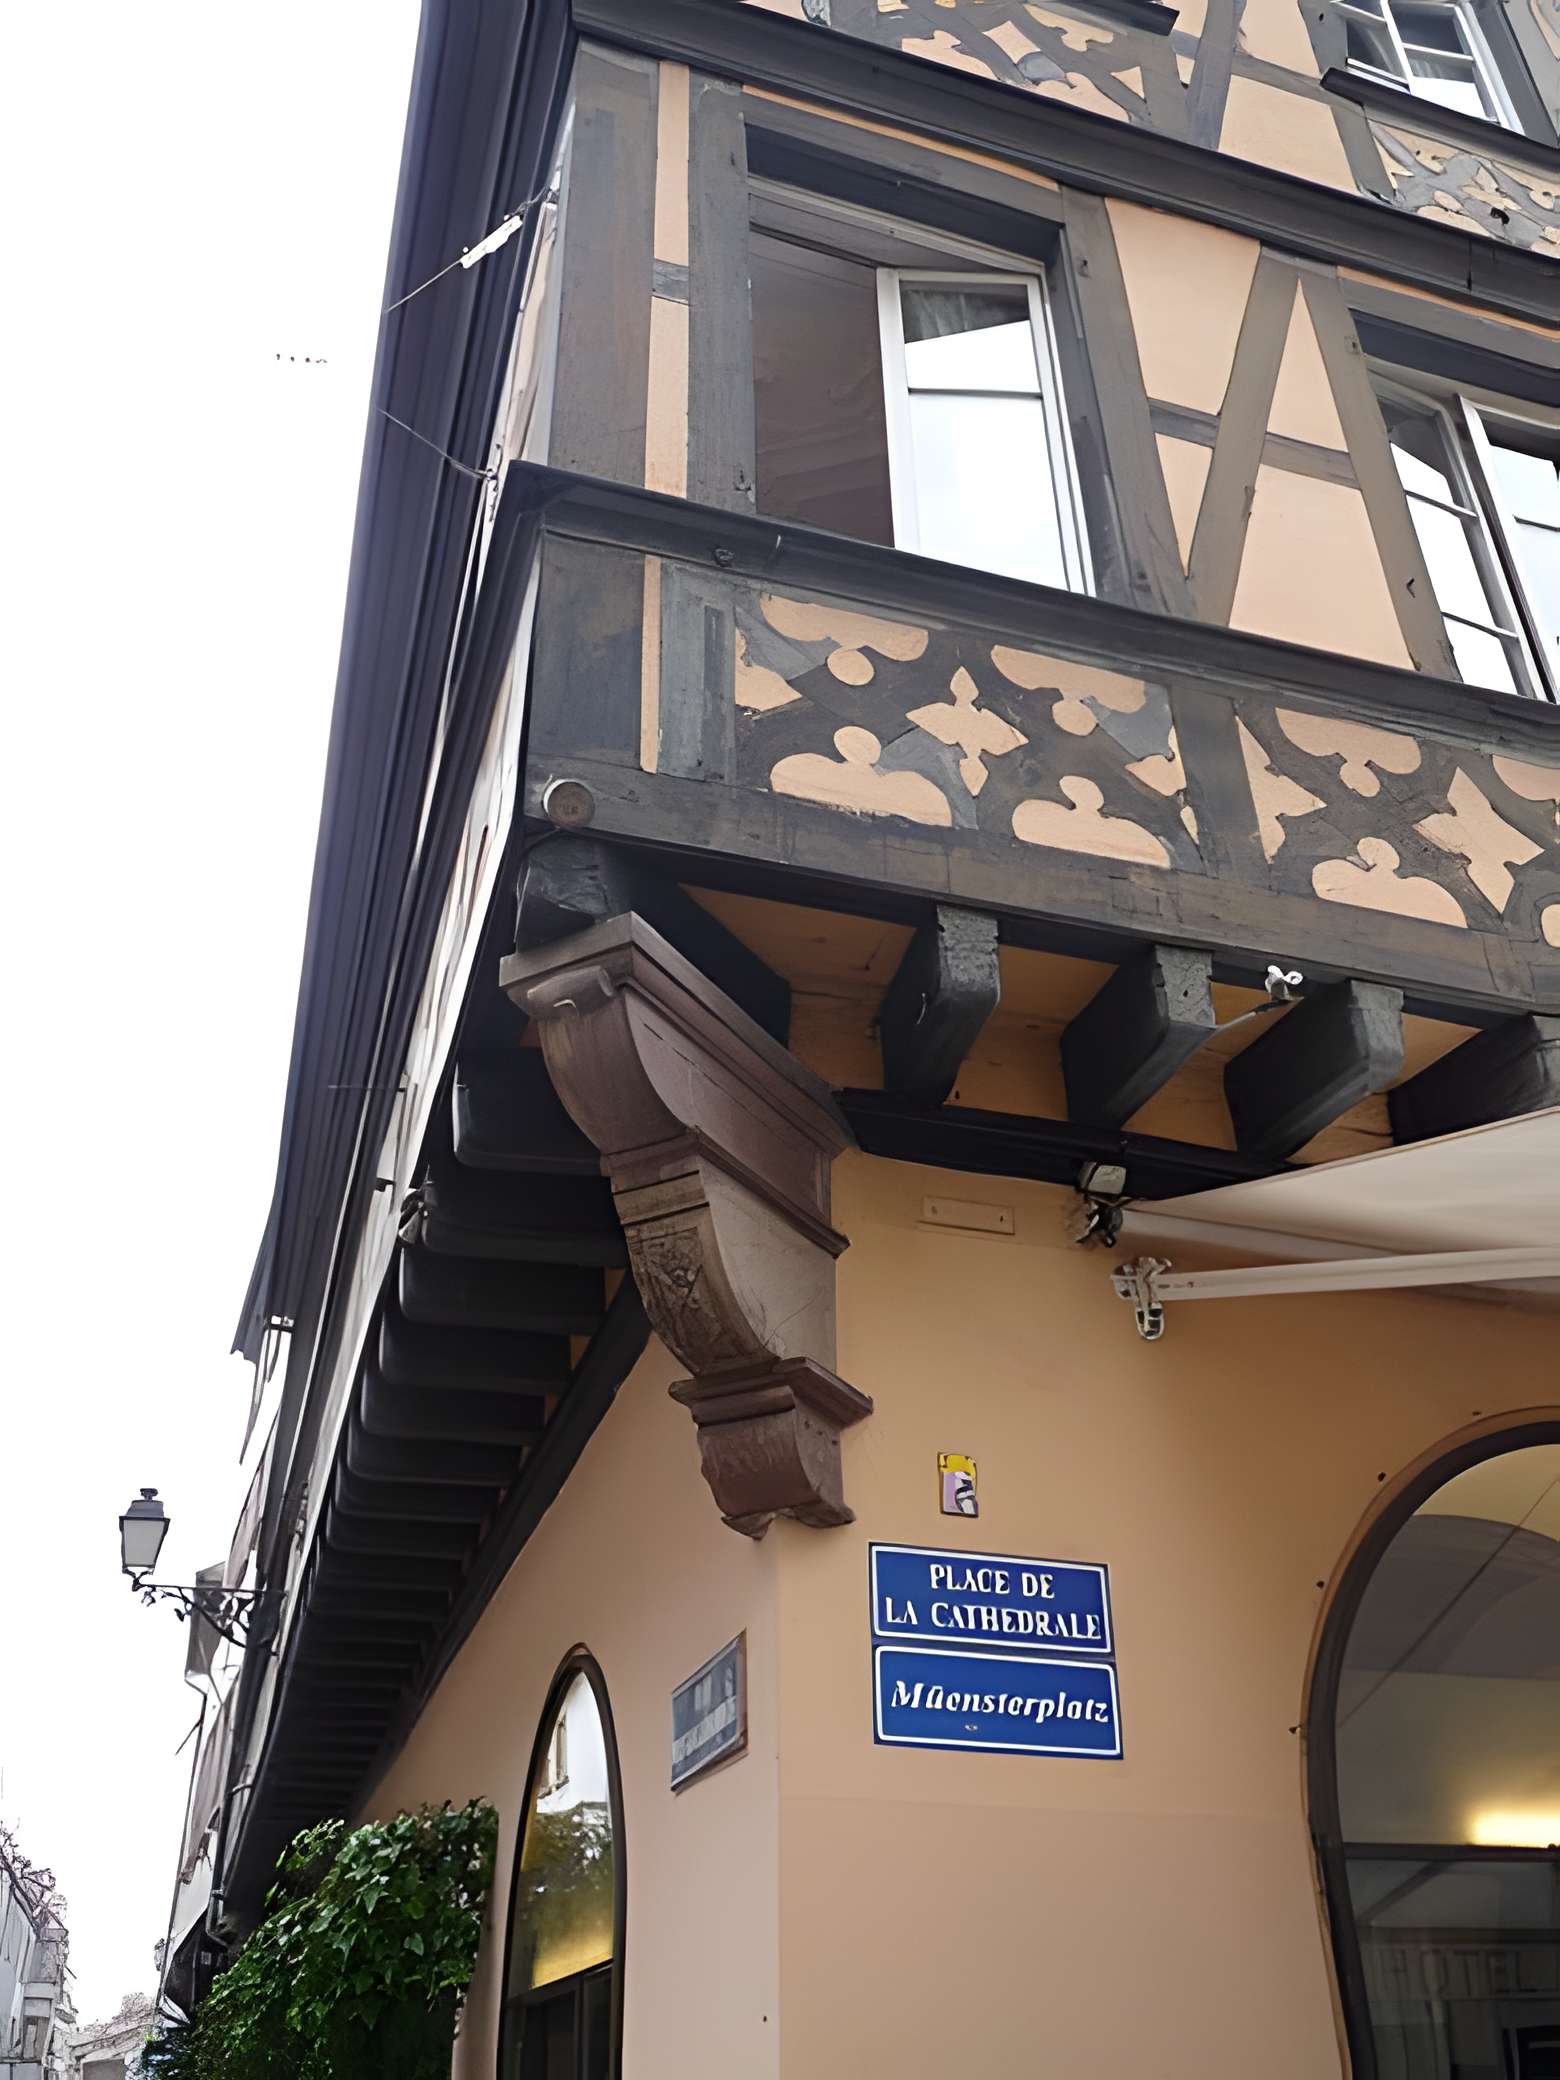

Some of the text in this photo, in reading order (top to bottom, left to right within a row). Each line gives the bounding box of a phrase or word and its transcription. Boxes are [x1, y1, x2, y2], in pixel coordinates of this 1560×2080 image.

[930, 1563, 1055, 1599] PLACE DE
[885, 1597, 1102, 1639] LA CATHEDRALE
